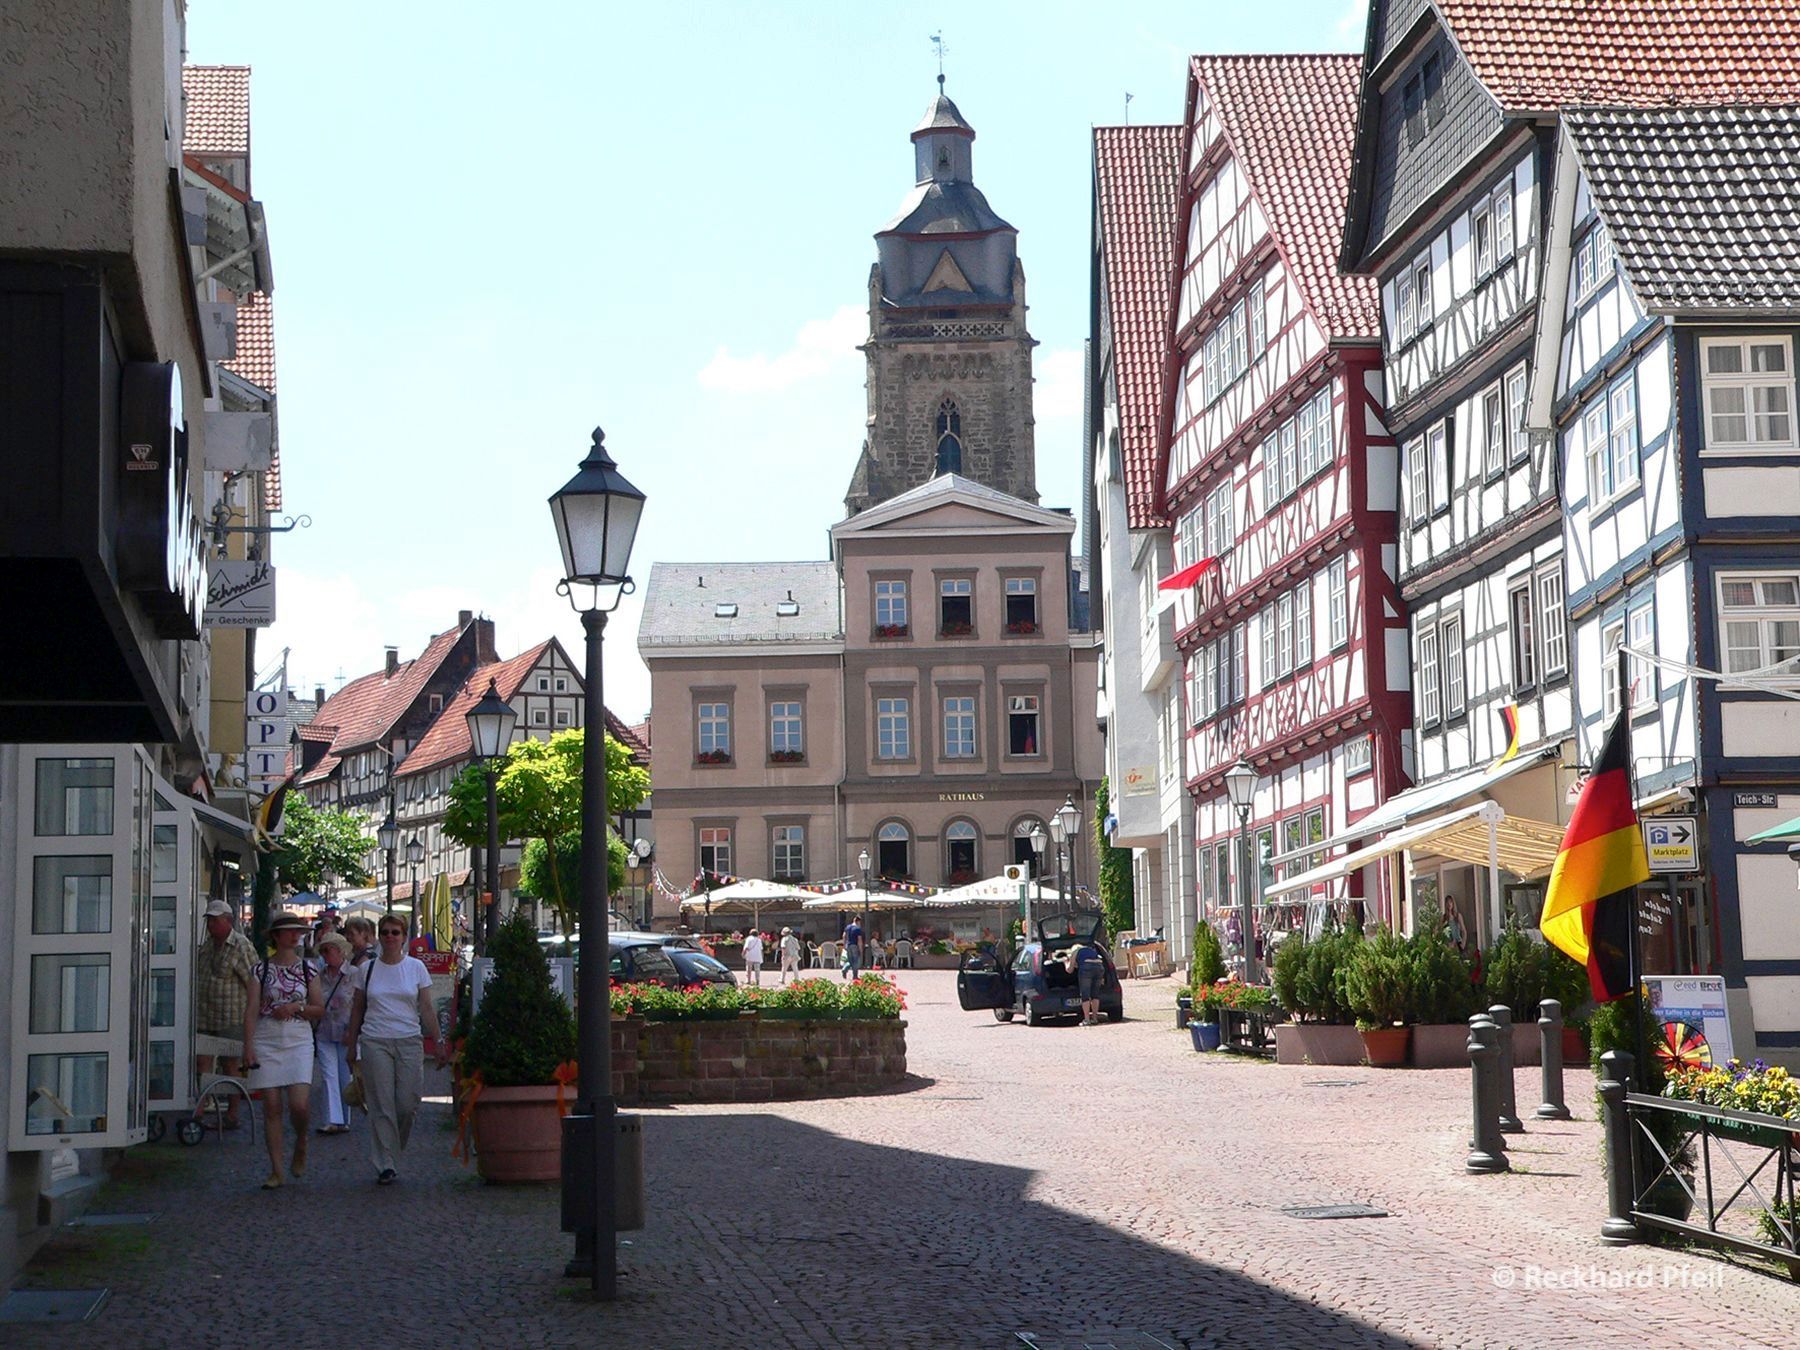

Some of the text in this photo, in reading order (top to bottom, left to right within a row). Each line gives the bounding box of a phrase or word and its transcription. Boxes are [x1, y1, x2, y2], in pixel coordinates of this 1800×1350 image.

[219, 616, 270, 625] Geschenke
[939, 792, 984, 801] RATHAUS
[1655, 832, 1664, 843] P
[1653, 848, 1688, 857] Marktplatz
